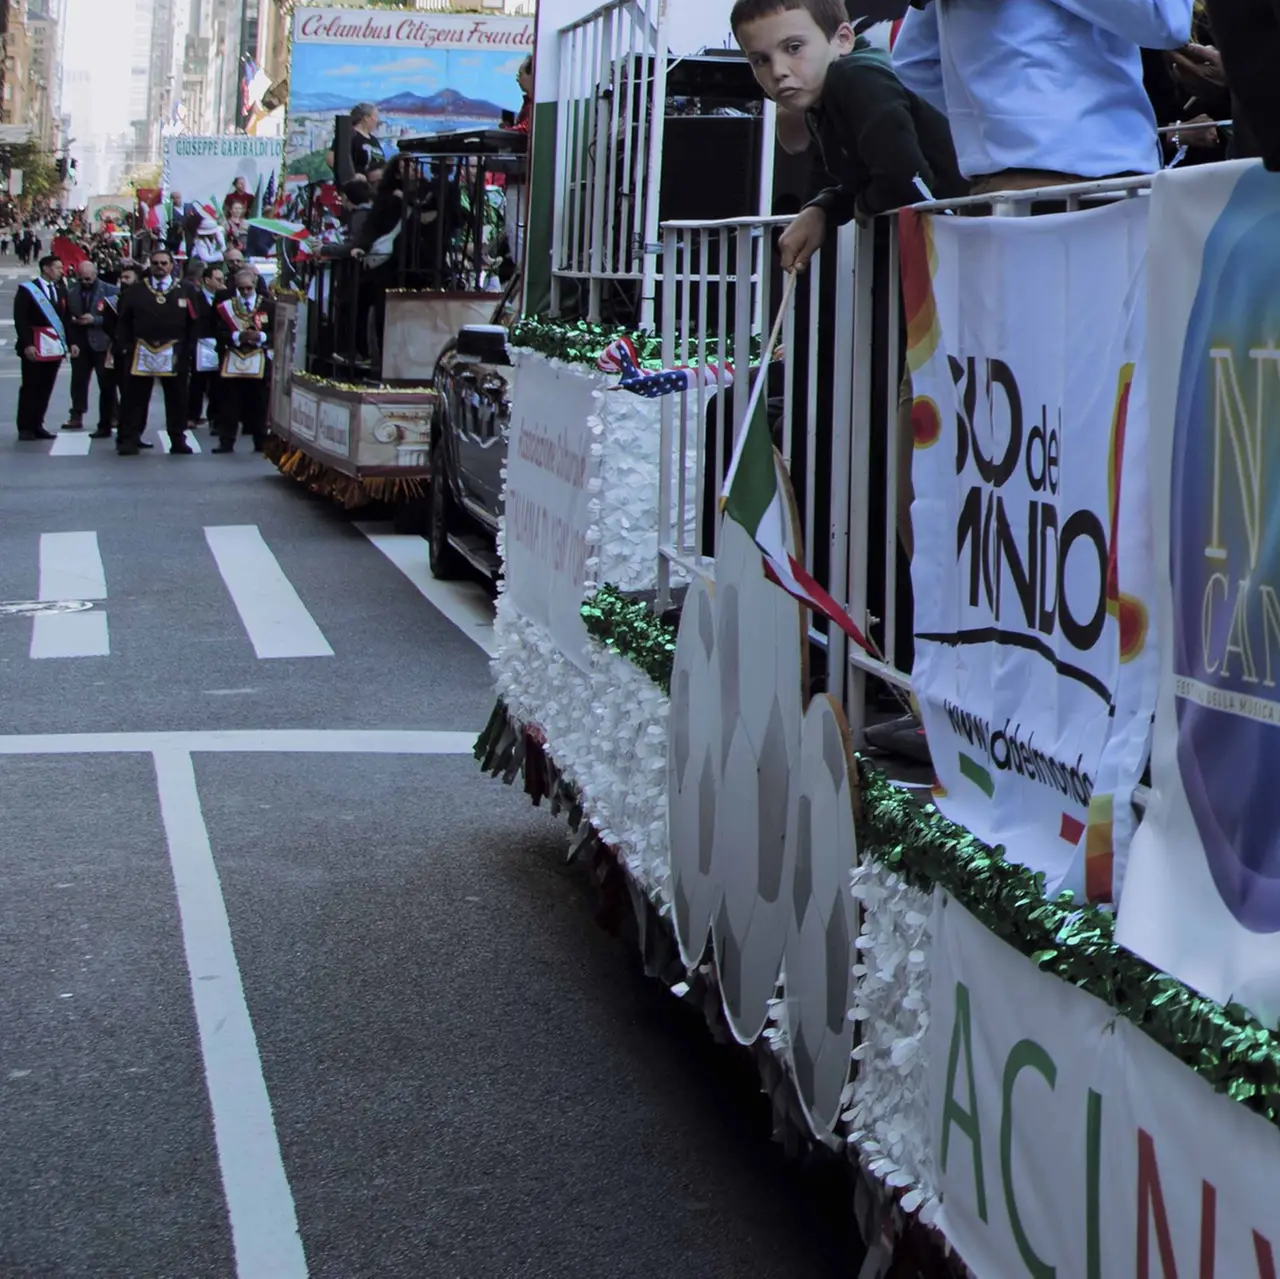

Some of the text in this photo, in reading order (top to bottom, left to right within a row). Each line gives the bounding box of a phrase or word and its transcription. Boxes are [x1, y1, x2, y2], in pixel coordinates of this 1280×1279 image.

[301, 14, 391, 39] Columbus
[395, 19, 464, 48] Citizens
[176, 141, 218, 157] GIUSEPPE
[221, 141, 267, 157] GARIBALDI
[1206, 692, 1234, 709] DELLA
[1239, 700, 1274, 719] MUSICA
[940, 981, 1278, 1279] ACIN
